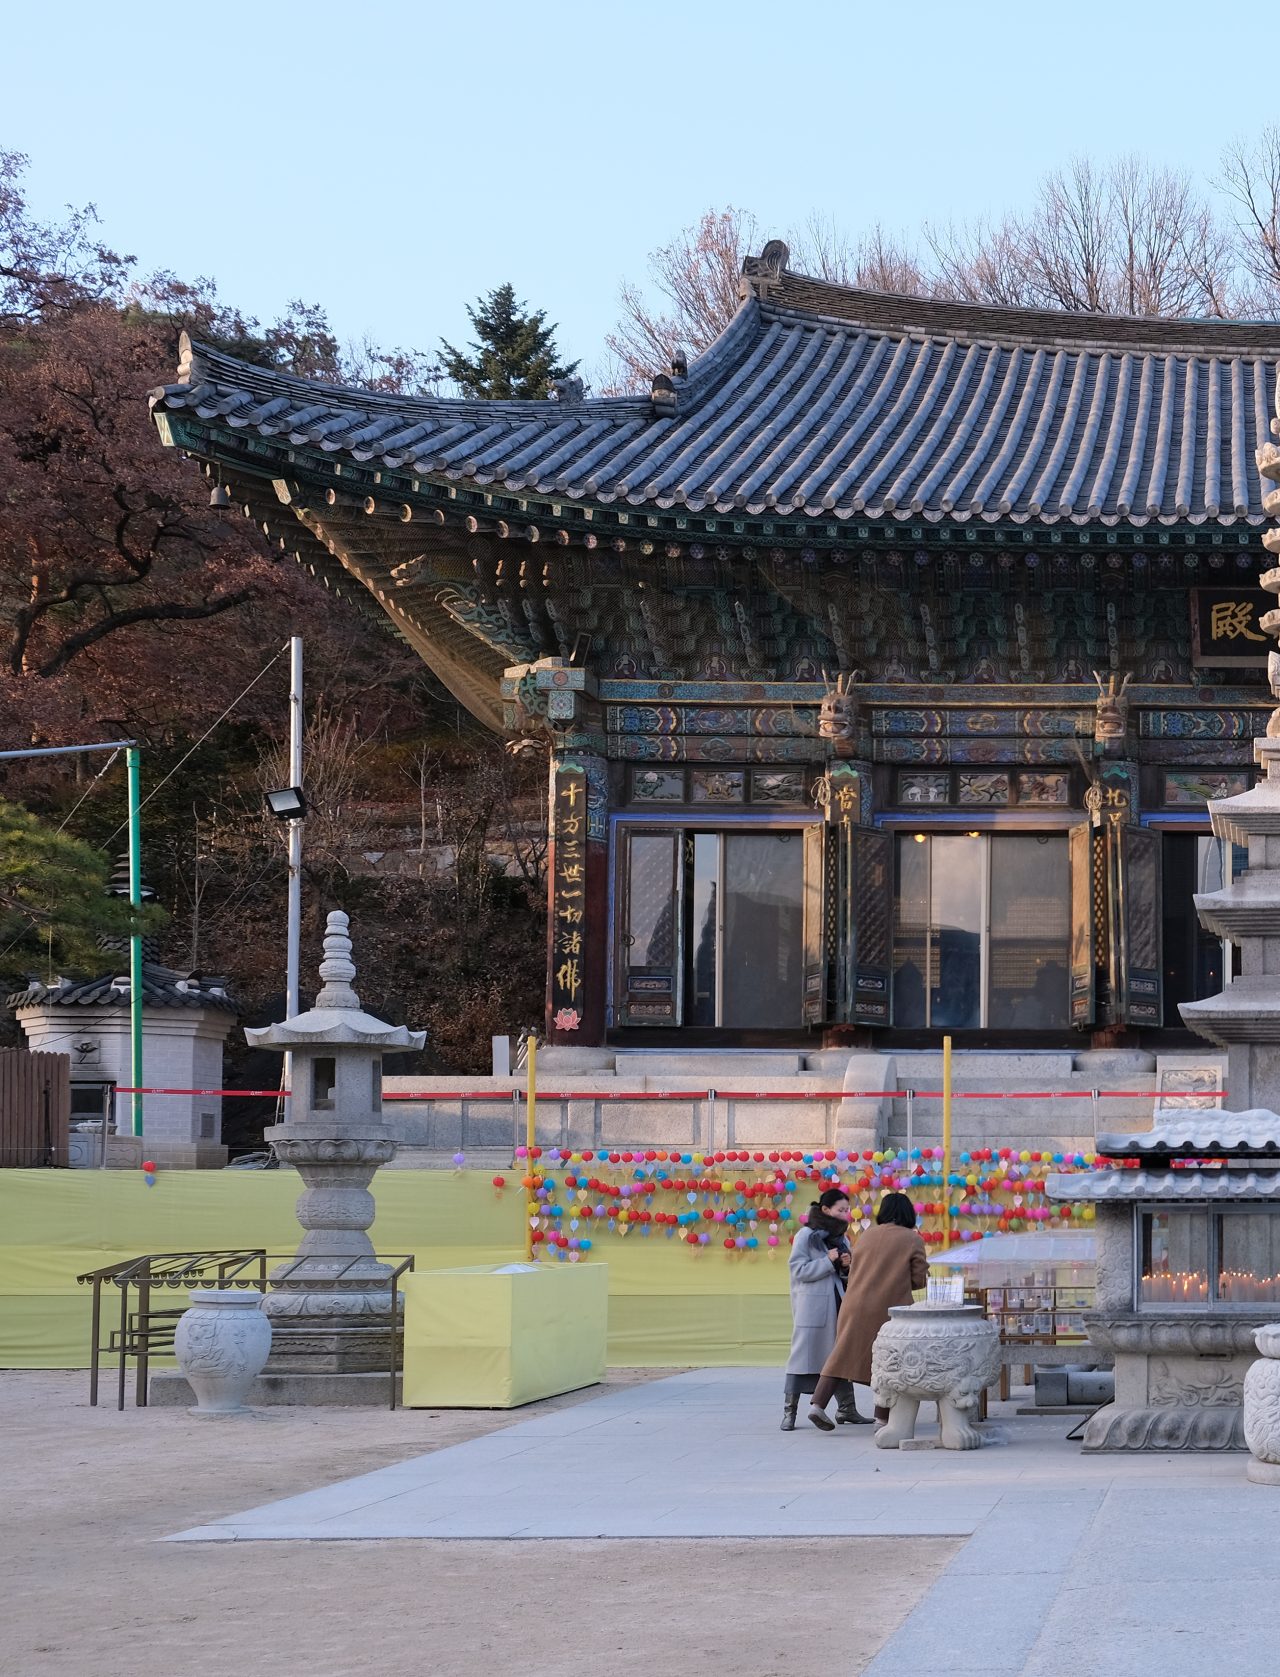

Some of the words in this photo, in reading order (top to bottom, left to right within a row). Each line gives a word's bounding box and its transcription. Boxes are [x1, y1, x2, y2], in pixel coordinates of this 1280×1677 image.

[555, 782, 585, 1003] 十方三世一切諸佛
